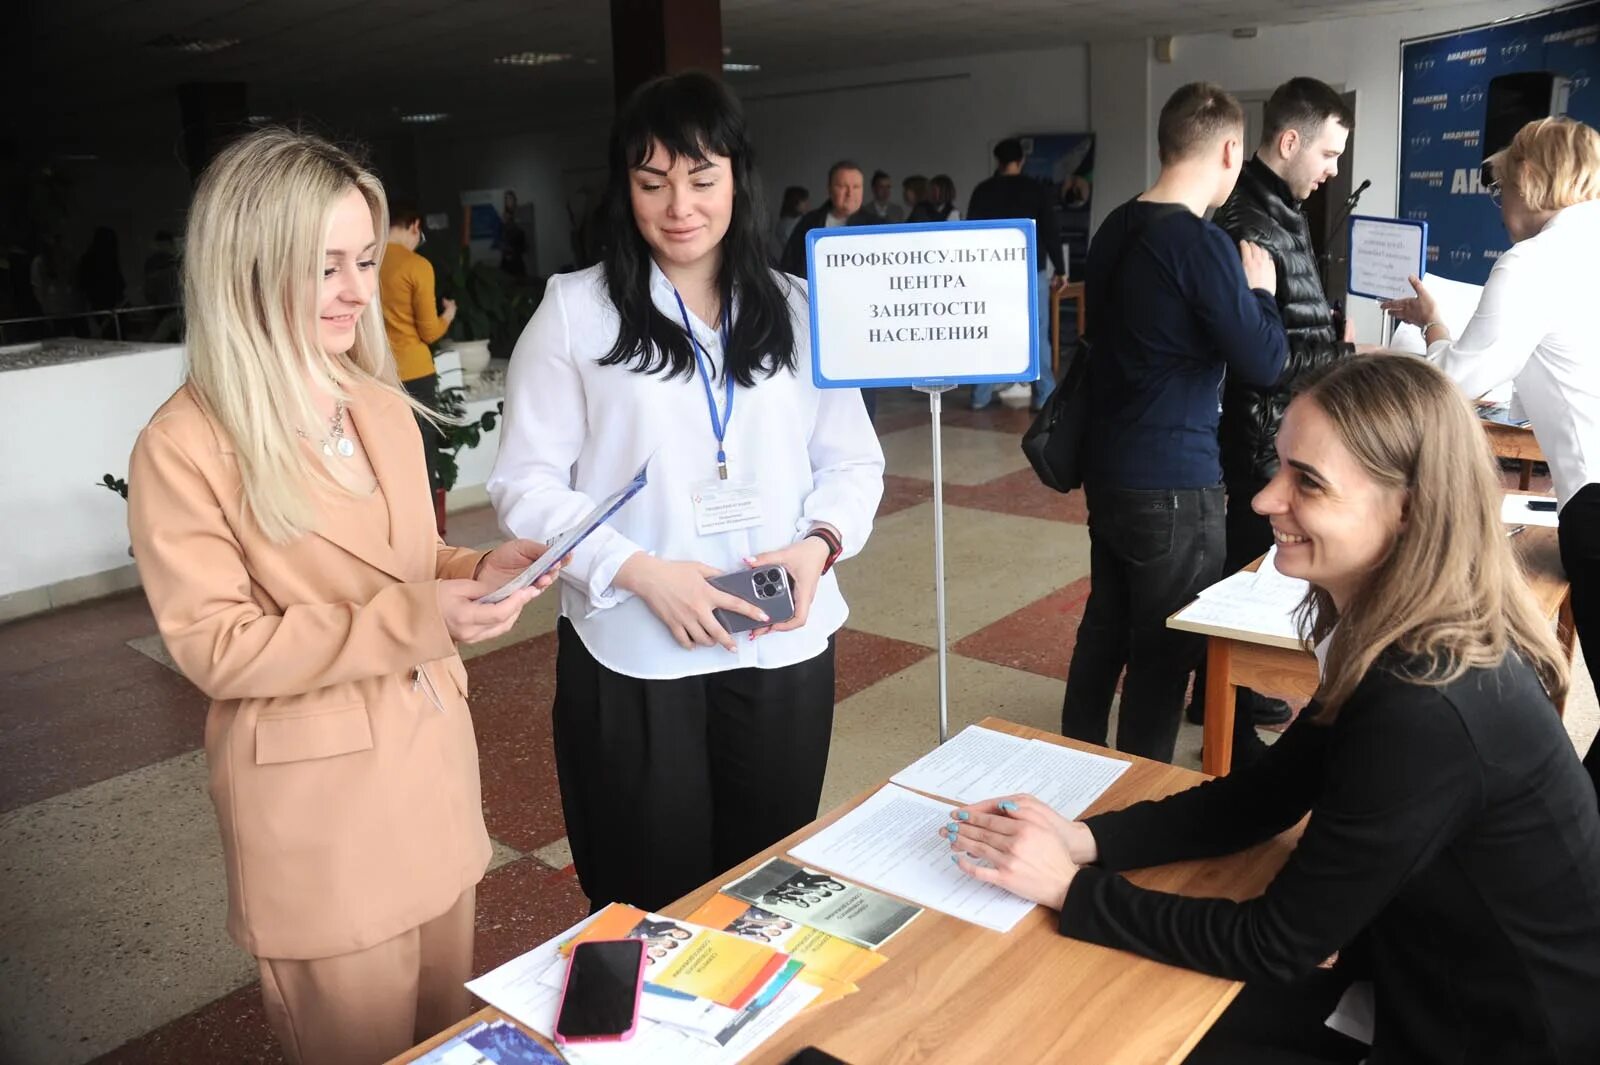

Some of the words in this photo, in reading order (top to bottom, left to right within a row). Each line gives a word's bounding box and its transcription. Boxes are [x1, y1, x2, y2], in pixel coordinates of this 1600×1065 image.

[1447, 47, 1487, 62] АКАДЕМИЯ
[1412, 93, 1448, 105] АКАДЕМИЯ
[1442, 129, 1480, 140] АКАДЕМИЯ
[826, 247, 1028, 268] ПРОФКОНСУЛЬТАНТ
[889, 274, 967, 292] ЦЕНТРА
[868, 301, 987, 319] ЗАНЯТОСТИ
[868, 325, 990, 343] НАСЕЛЕНИЯ
